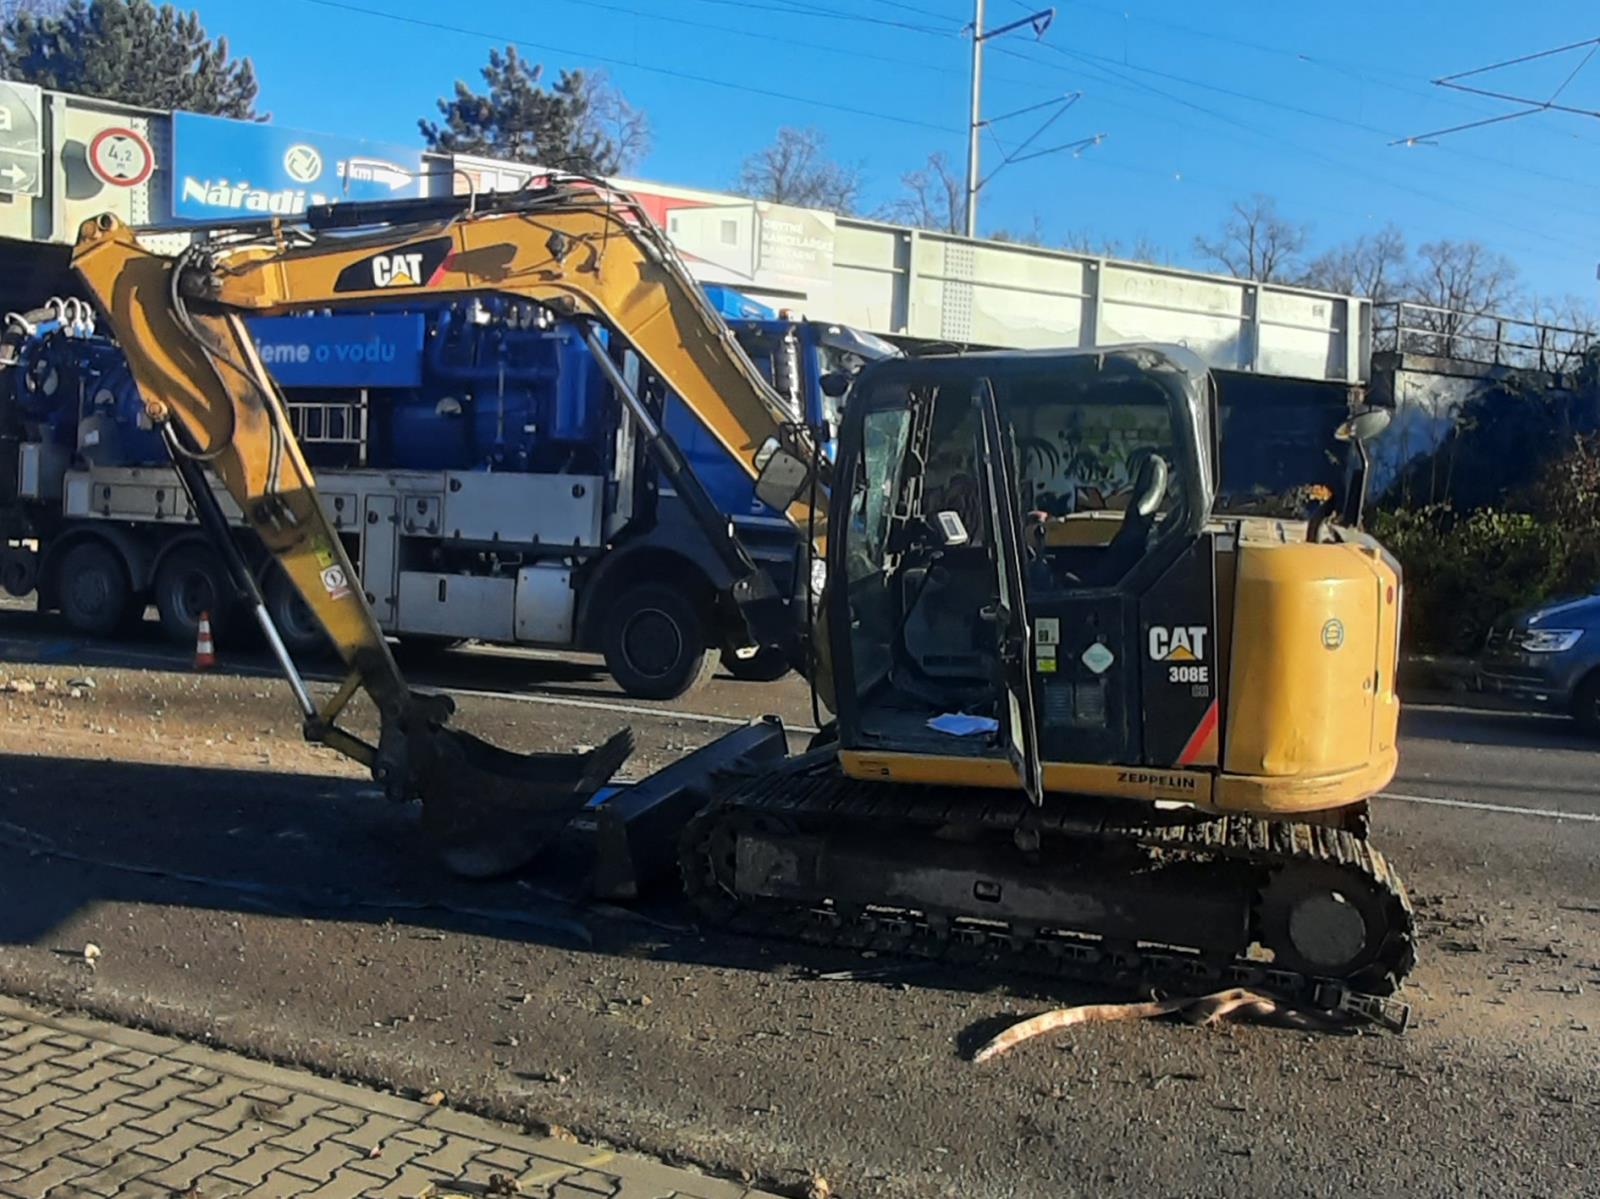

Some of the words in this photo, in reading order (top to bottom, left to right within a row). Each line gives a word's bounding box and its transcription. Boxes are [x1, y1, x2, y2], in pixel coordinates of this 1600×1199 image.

[372, 253, 424, 287] CAT
[315, 344, 330, 362] o
[334, 336, 396, 362] vodu
[1148, 626, 1208, 661] CAT
[1169, 666, 1209, 683] 308E
[1117, 772, 1195, 788] ZEPPELIN
